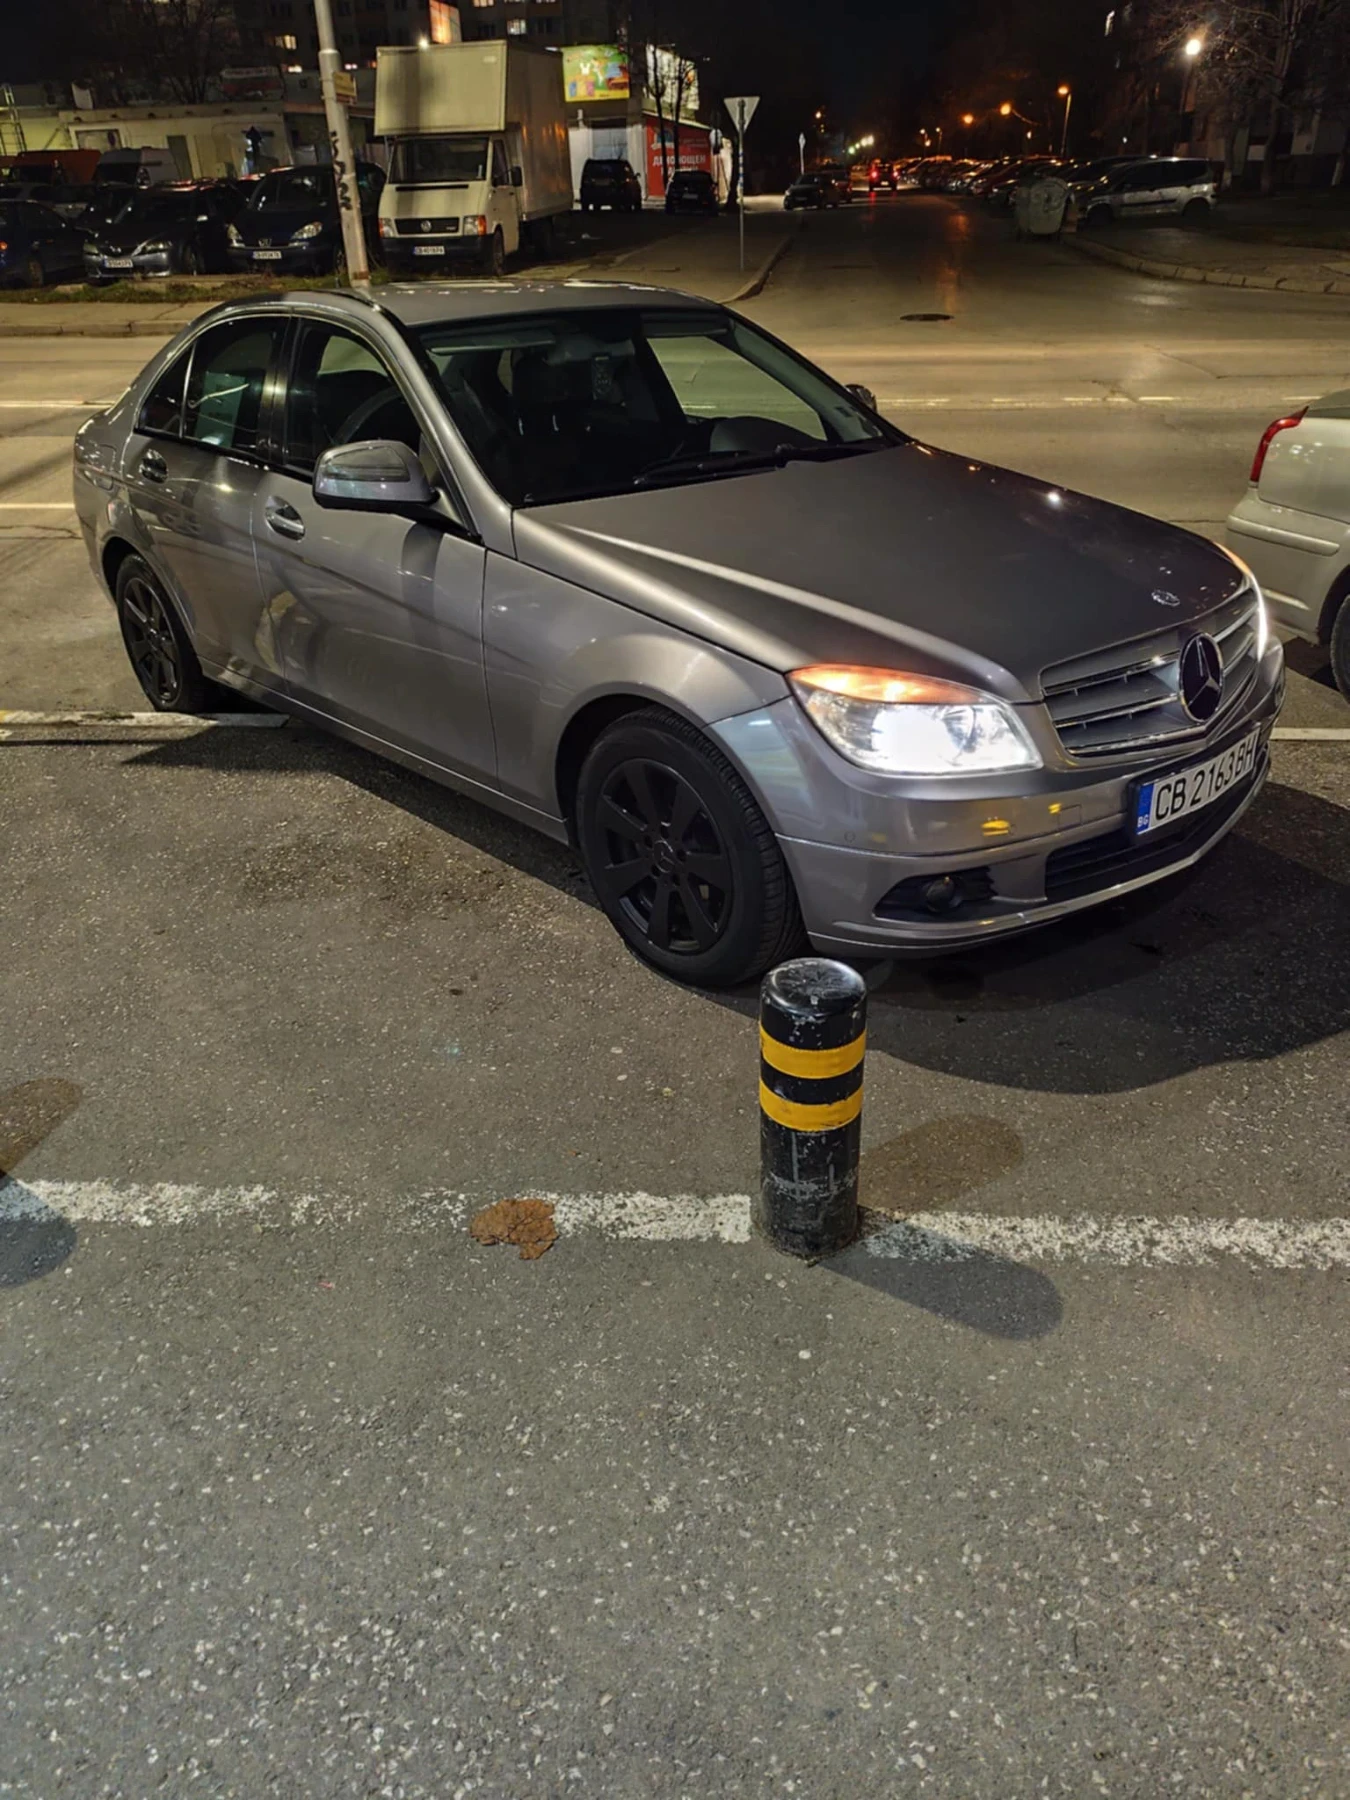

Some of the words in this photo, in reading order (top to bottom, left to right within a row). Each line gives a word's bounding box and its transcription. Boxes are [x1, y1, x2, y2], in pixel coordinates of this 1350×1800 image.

[1155, 777, 1186, 820] CB
[1189, 751, 1234, 807] 2163
[1137, 814, 1149, 828] BG
